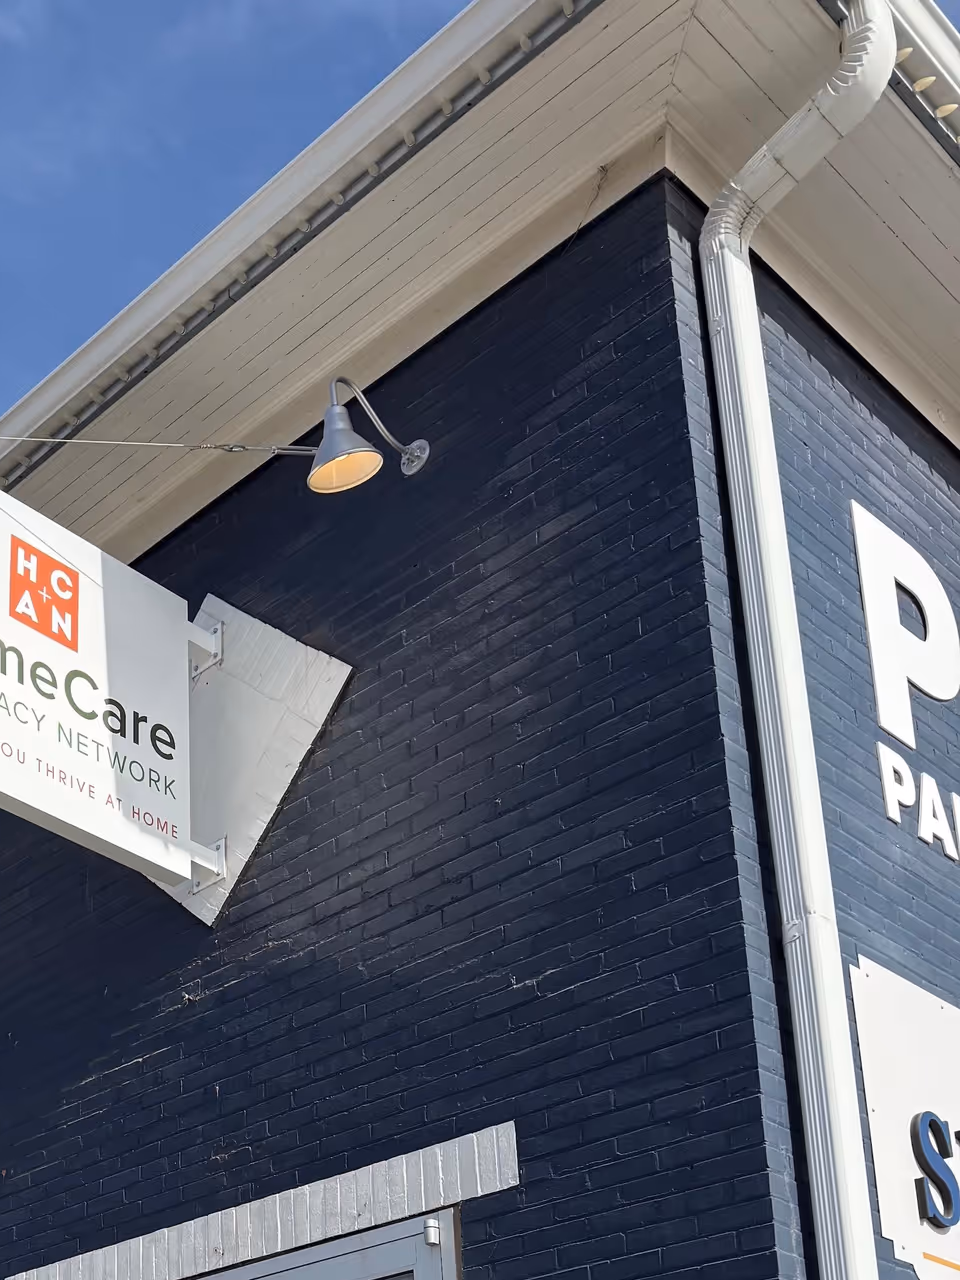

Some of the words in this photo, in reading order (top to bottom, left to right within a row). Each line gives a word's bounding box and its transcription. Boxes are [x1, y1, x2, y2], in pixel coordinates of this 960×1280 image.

[36, 758, 96, 799] THRIVE
[105, 794, 123, 812] AT
[132, 805, 178, 839] HOME
[58, 721, 177, 800] NETWORK
[874, 741, 960, 863] PA
